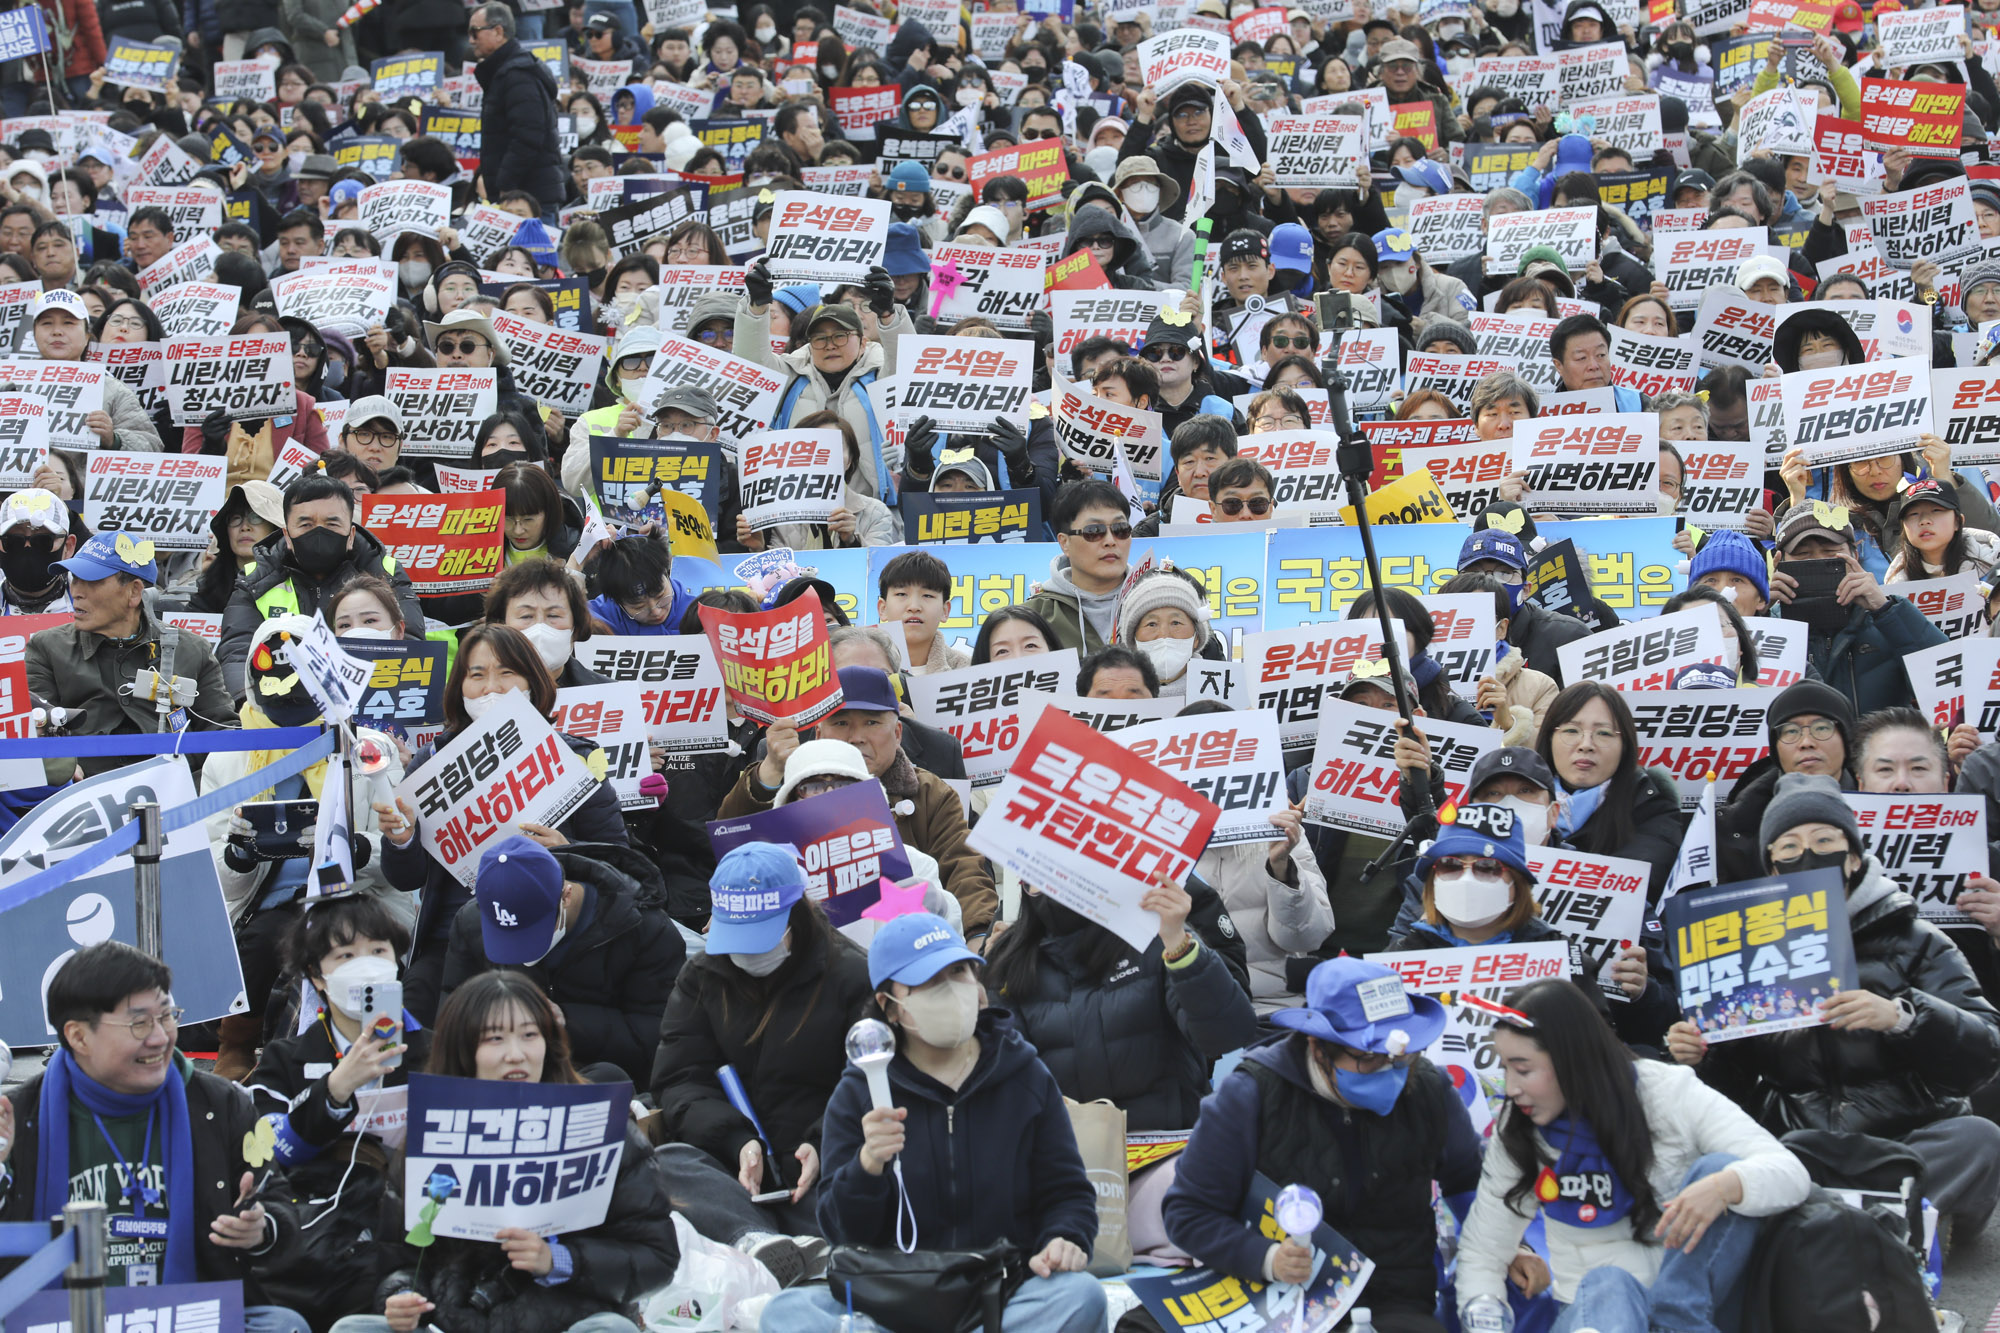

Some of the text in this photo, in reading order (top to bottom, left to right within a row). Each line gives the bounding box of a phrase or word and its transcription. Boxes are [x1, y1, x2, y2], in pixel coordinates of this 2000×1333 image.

[1793, 10, 1830, 31] 파면!
[1883, 22, 1947, 41] 내란세력
[1150, 35, 1218, 57] 국힘당을
[1891, 36, 1956, 55] 청산하자
[376, 65, 408, 79] 내란
[1148, 52, 1228, 83] 해산하라!
[1480, 72, 1543, 90] 내란세력
[1617, 99, 1657, 112] 단결하여
[1863, 84, 1960, 115] 윤석열 파면!
[1271, 116, 1358, 134] 애국으로 단결하여
[1395, 112, 1431, 130] 파면!
[1863, 113, 1958, 145] 국힘당 해산!
[1271, 134, 1342, 154] 내란세력
[971, 147, 1059, 179] 윤석열 파면!
[1276, 154, 1350, 175] 청산하자
[1471, 155, 1500, 173] 내란
[402, 182, 448, 199] 단결하여
[1027, 172, 1066, 198] 해산!
[1630, 177, 1668, 201] 종식
[363, 196, 435, 217] 내란세력
[1412, 199, 1452, 215] 애국으로
[1864, 185, 1965, 215] 애국으로 단결하여
[780, 202, 876, 232] 윤석열을
[1545, 208, 1592, 223] 단결하여
[1873, 203, 1952, 238] 내란세력
[1491, 221, 1574, 243] 내란세력
[1885, 226, 1967, 258] 청산하자
[174, 239, 211, 267] 단결하여
[770, 233, 880, 264] 파면하라!
[997, 252, 1040, 269] 국힘당
[1671, 237, 1755, 262] 윤석열을
[664, 270, 714, 285] 애국으로
[1056, 253, 1090, 281] 윤석열
[184, 285, 236, 303] 단결하여
[337, 277, 388, 292] 단결하여
[45, 296, 73, 304] GATES
[978, 289, 1040, 315] 해산!
[1069, 300, 1157, 323] 국힘당을
[494, 315, 600, 355] 애국으로 단결하여
[1471, 317, 1520, 333] 애국으로
[108, 349, 162, 365] 단결하여
[167, 340, 286, 360] 애국으로 단결하여
[914, 347, 1018, 376] 윤석열을
[1617, 339, 1694, 369] 국힘당을
[42, 366, 100, 384] 단결하여
[171, 359, 269, 386] 내란세력
[660, 338, 780, 393] 애국으로 단결하여
[1409, 360, 1461, 375] 애국으로
[438, 374, 492, 391] 단결하여
[902, 381, 1024, 412] 파면하라!
[1803, 371, 1912, 409] 윤석열을
[182, 384, 282, 411] 청산하자
[1060, 392, 1147, 438] 윤석열을
[1795, 397, 1926, 444] 파면하라!
[1366, 428, 1431, 445] 내란수괴
[1533, 426, 1642, 457] 윤석열을
[90, 457, 222, 479] 애국으로 단결하여
[602, 456, 710, 482] 내란 종식
[744, 441, 830, 475] 윤석열을
[440, 470, 478, 490] 애국으로
[1524, 461, 1655, 492] 파면하라!
[89, 476, 203, 506] 내란세력
[742, 475, 840, 509] 파면하라!
[99, 506, 208, 534] 청산하자
[367, 504, 500, 536] 윤석열 파면!
[919, 508, 1028, 539] 내란 종식
[440, 545, 500, 576] 해산!
[1496, 543, 1515, 556] INTER
[718, 612, 814, 659] 윤석열을
[594, 650, 699, 681] 국힘당을
[1584, 626, 1699, 677] 국힘당을
[369, 657, 433, 686] 종식
[723, 641, 830, 702] 파면하라!
[363, 688, 429, 718] 수호
[936, 671, 1060, 716] 국힘당을
[1633, 705, 1765, 738] 국힘당을
[415, 719, 523, 819] 국힘당을
[680, 763, 695, 771] LIES
[434, 734, 565, 865] 해산하라!
[1031, 741, 1200, 848] 극우국힘
[1457, 806, 1514, 837] 파면
[1884, 804, 1978, 829] 단결하여
[805, 828, 895, 872] 이름으로
[1004, 784, 1189, 888] 규탄한다!
[835, 857, 880, 895] 파면
[1548, 860, 1641, 894] 단결하여
[491, 901, 518, 927] LA
[914, 928, 952, 950] emis
[1678, 890, 1828, 967] 내란 종식
[1470, 953, 1563, 984] 단결하여
[1680, 934, 1830, 1009] 민주 수호
[423, 1101, 610, 1154] 김건희를
[422, 1147, 618, 1207] 수사하라!
[1560, 1174, 1612, 1208] 파면
[116, 1220, 168, 1235] 더불어민주당
